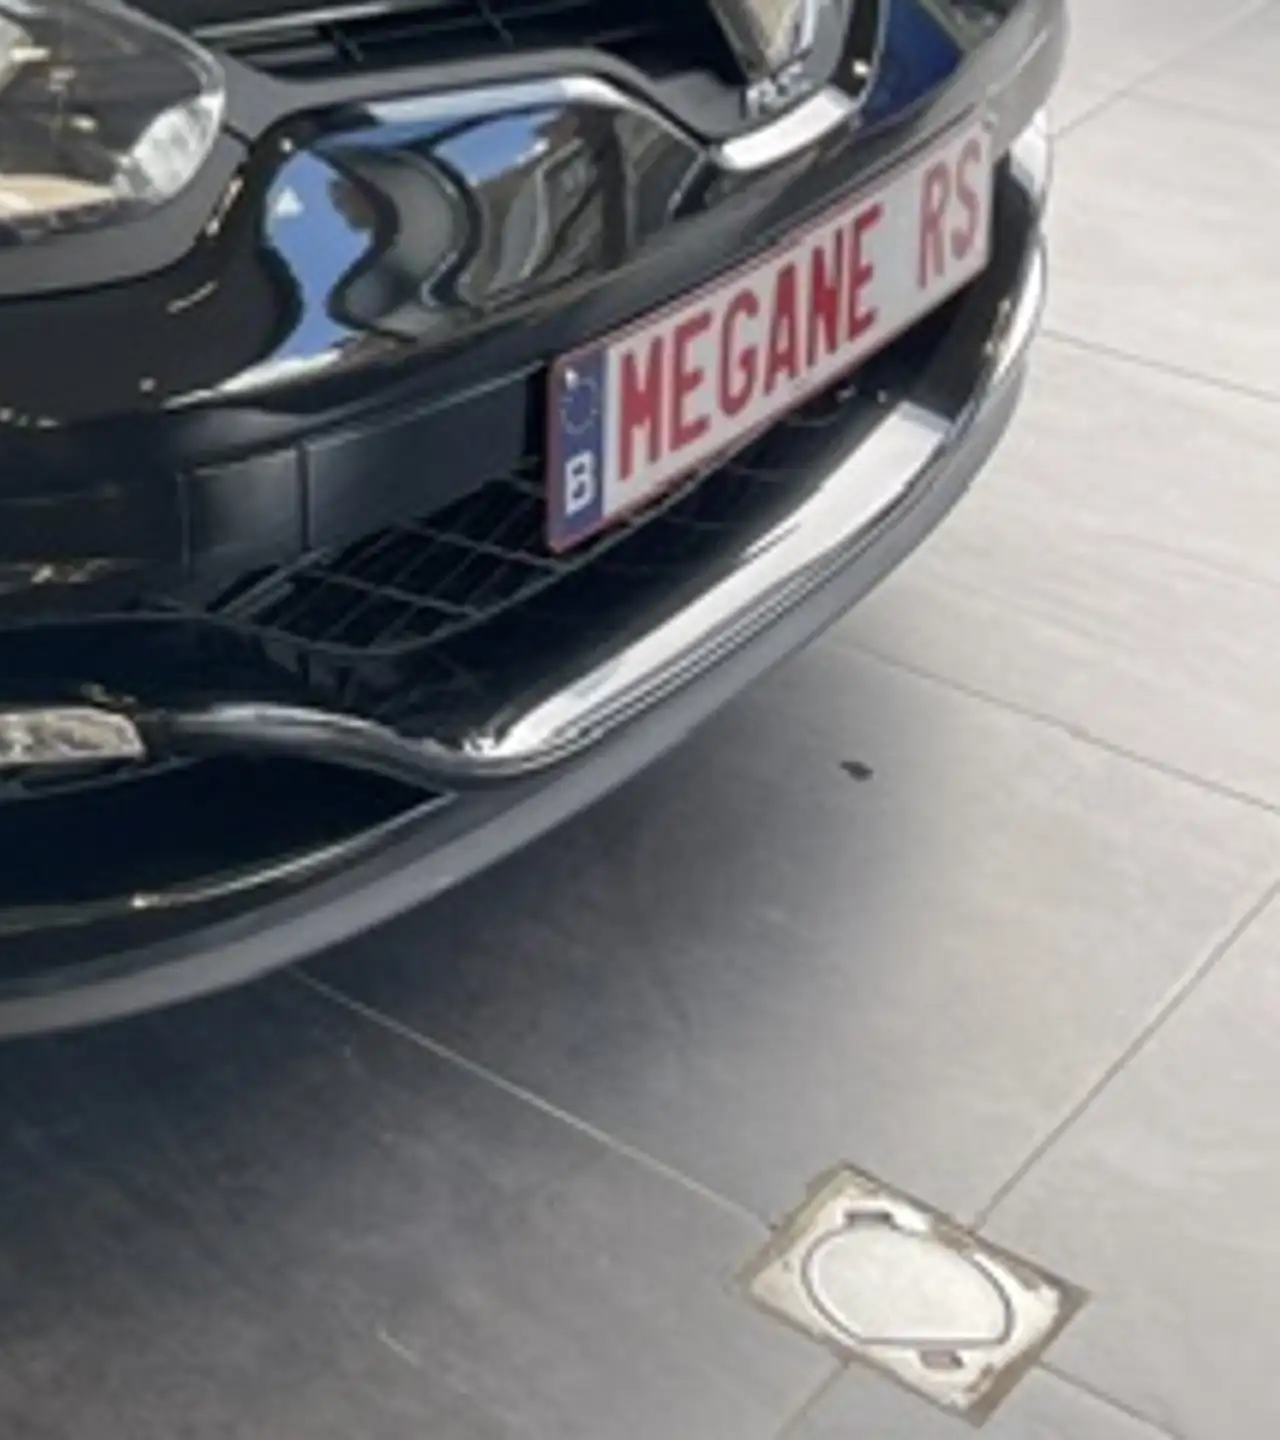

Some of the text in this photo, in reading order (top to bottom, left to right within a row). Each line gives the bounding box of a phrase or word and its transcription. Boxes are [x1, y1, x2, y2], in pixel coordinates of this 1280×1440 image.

[618, 138, 982, 481] MEGANE RS
[564, 454, 594, 516] B
